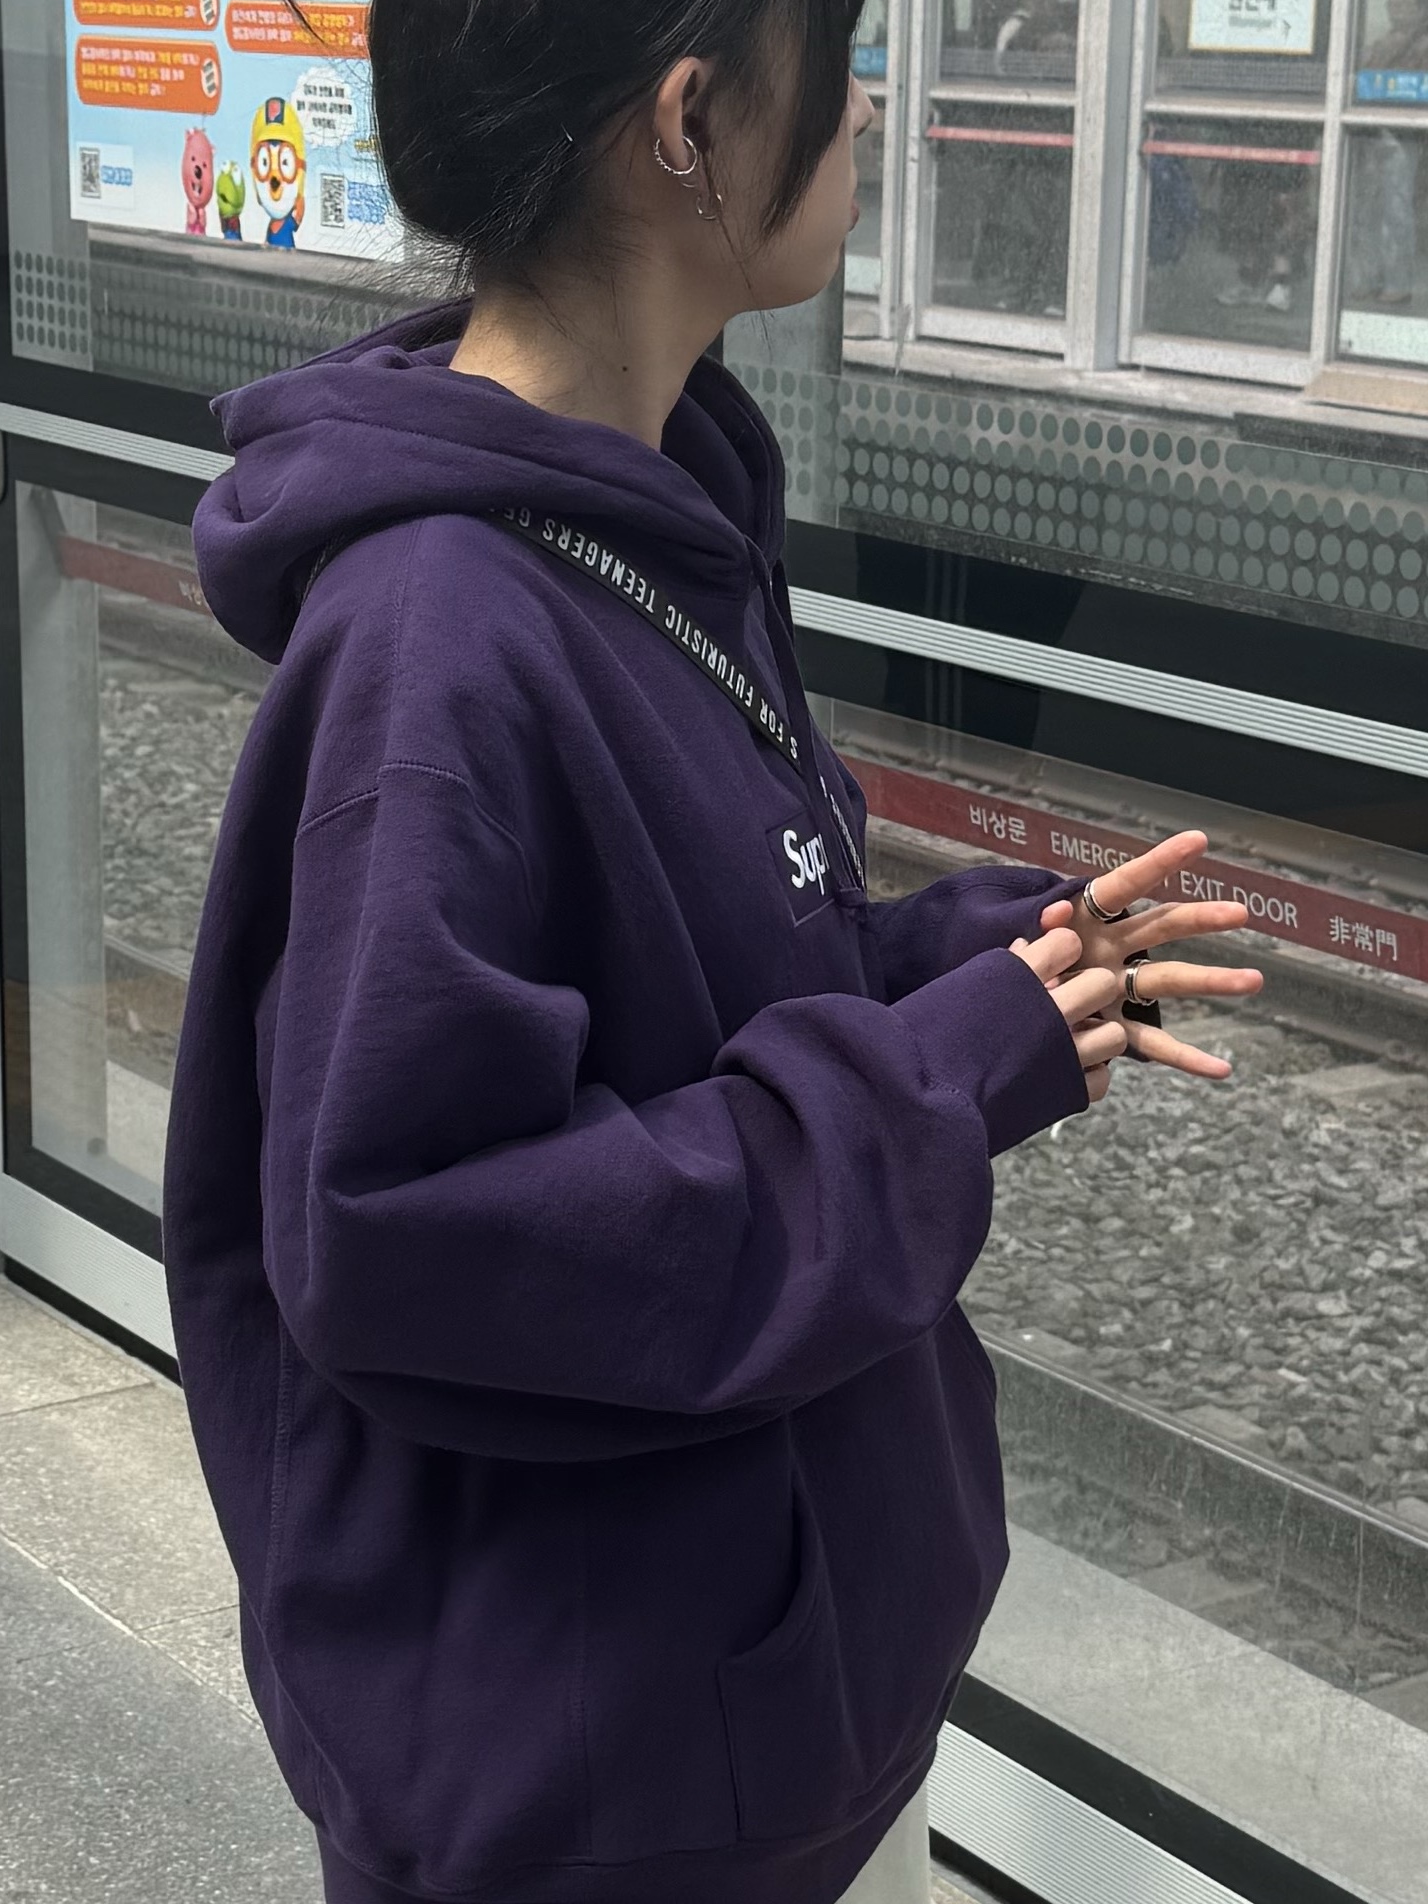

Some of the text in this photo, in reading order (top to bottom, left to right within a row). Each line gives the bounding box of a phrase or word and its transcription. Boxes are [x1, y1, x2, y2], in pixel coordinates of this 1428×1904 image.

[542, 518, 655, 614] TEENAGERS
[665, 605, 754, 708] FUTURISTIC
[759, 698, 784, 743] FOR
[969, 804, 1028, 846] 비상문
[1180, 870, 1225, 902] EXIT
[1233, 885, 1299, 930] DOOR
[1329, 914, 1399, 962] 非常門
